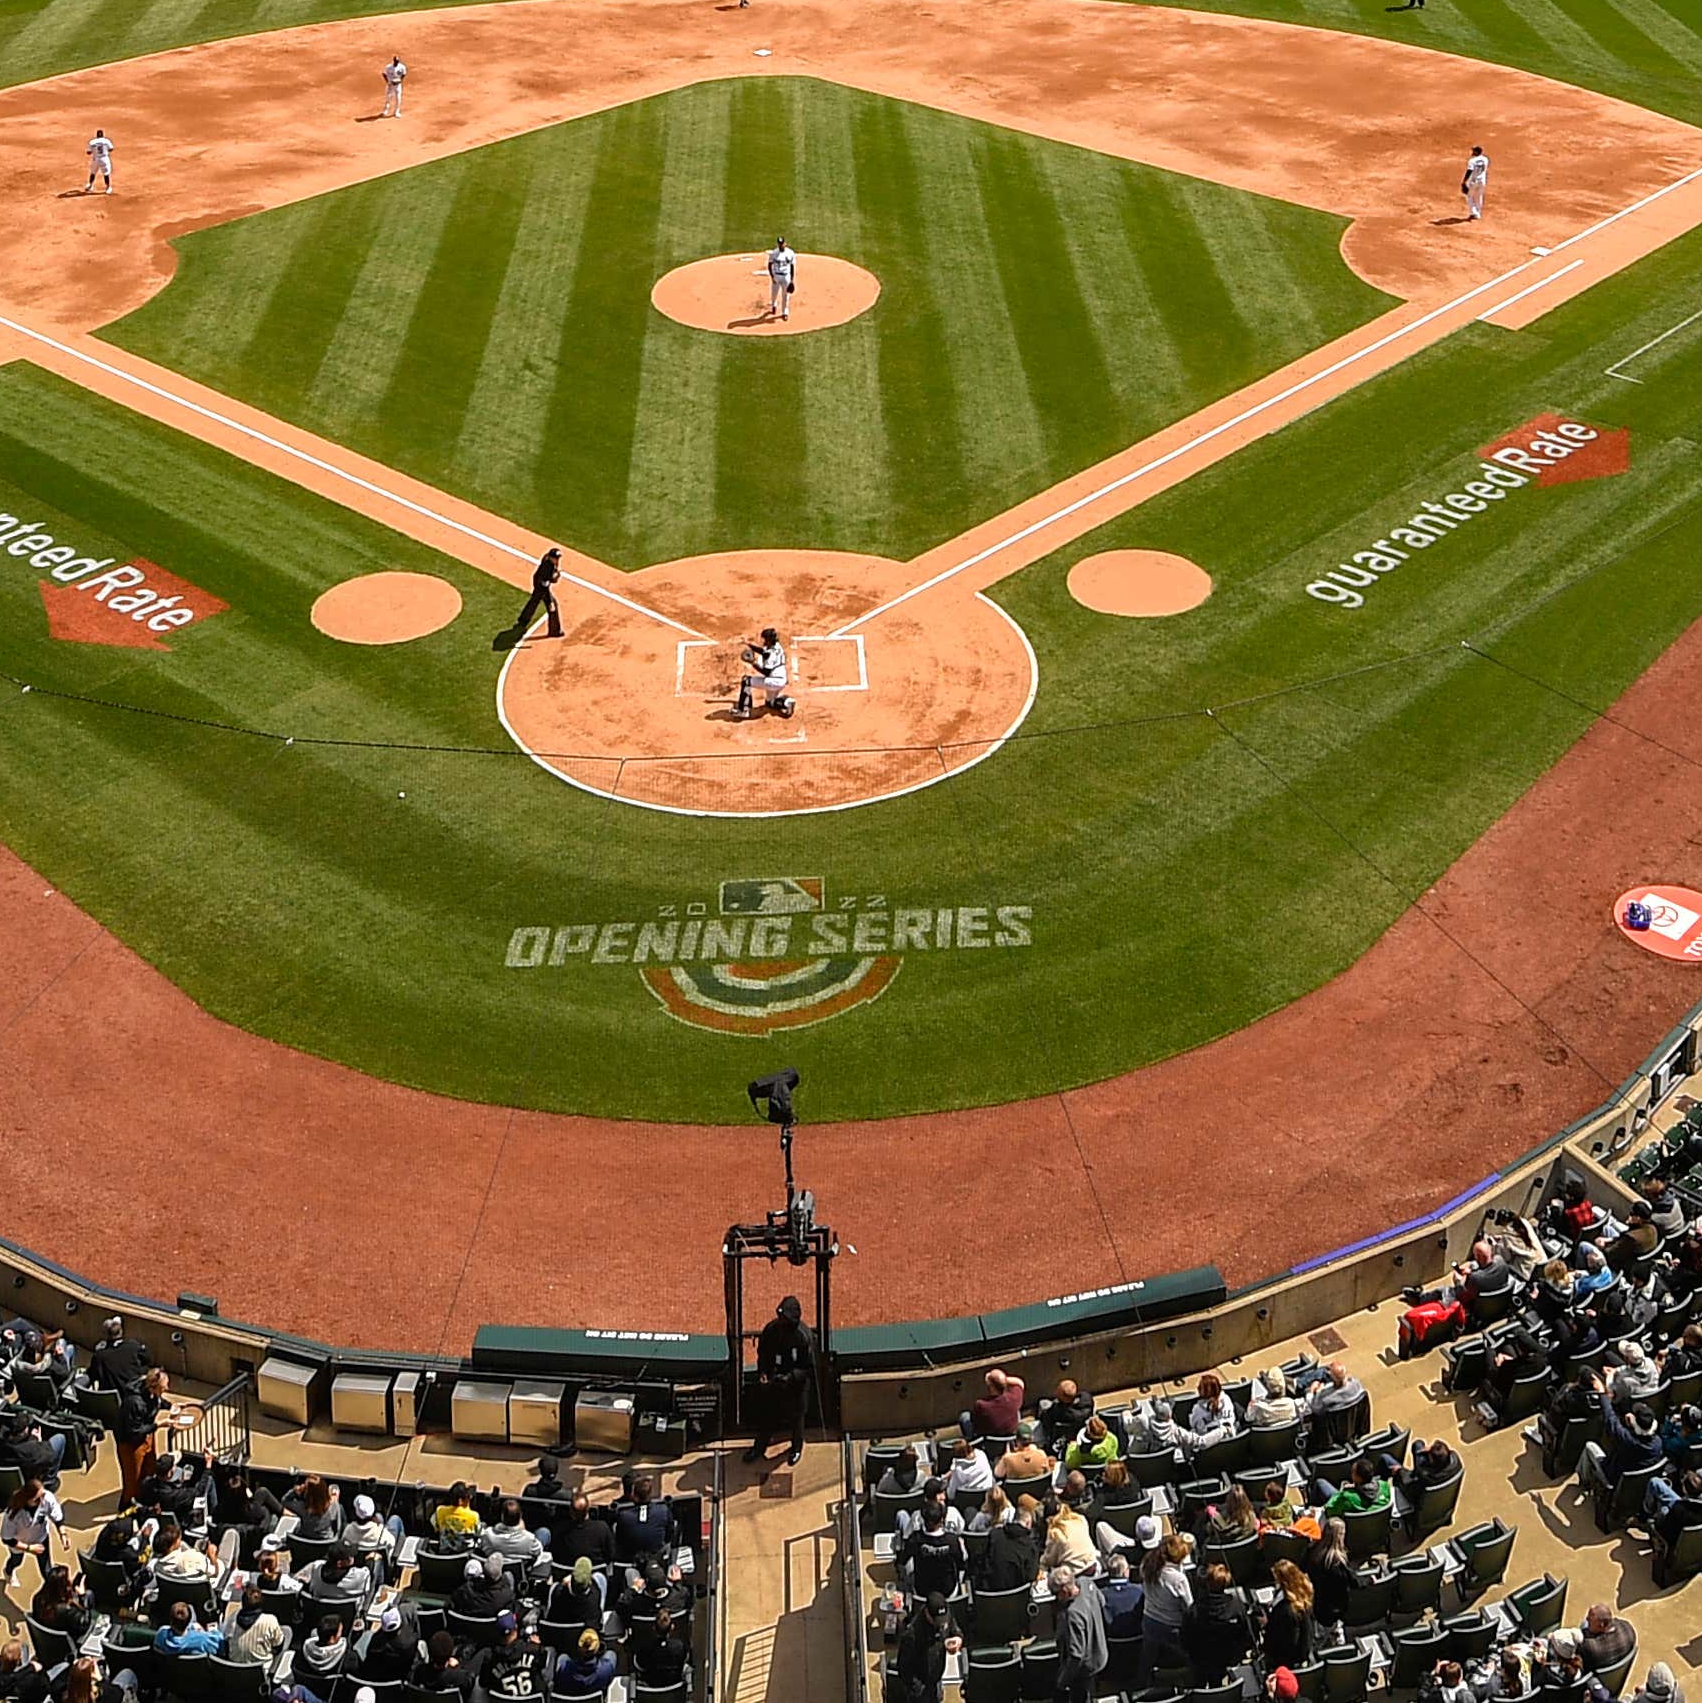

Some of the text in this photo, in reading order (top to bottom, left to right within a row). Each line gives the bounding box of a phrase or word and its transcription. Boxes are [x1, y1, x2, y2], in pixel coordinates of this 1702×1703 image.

[504, 905, 1034, 969] OPENING SERIES
[1111, 1281, 1145, 1295] PLEASE
[1079, 1291, 1097, 1300] NOT
[619, 1331, 638, 1340] NOT
[639, 1332, 653, 1341] DO
[654, 1332, 689, 1342] PLEASE
[502, 1671, 533, 1697] 56
